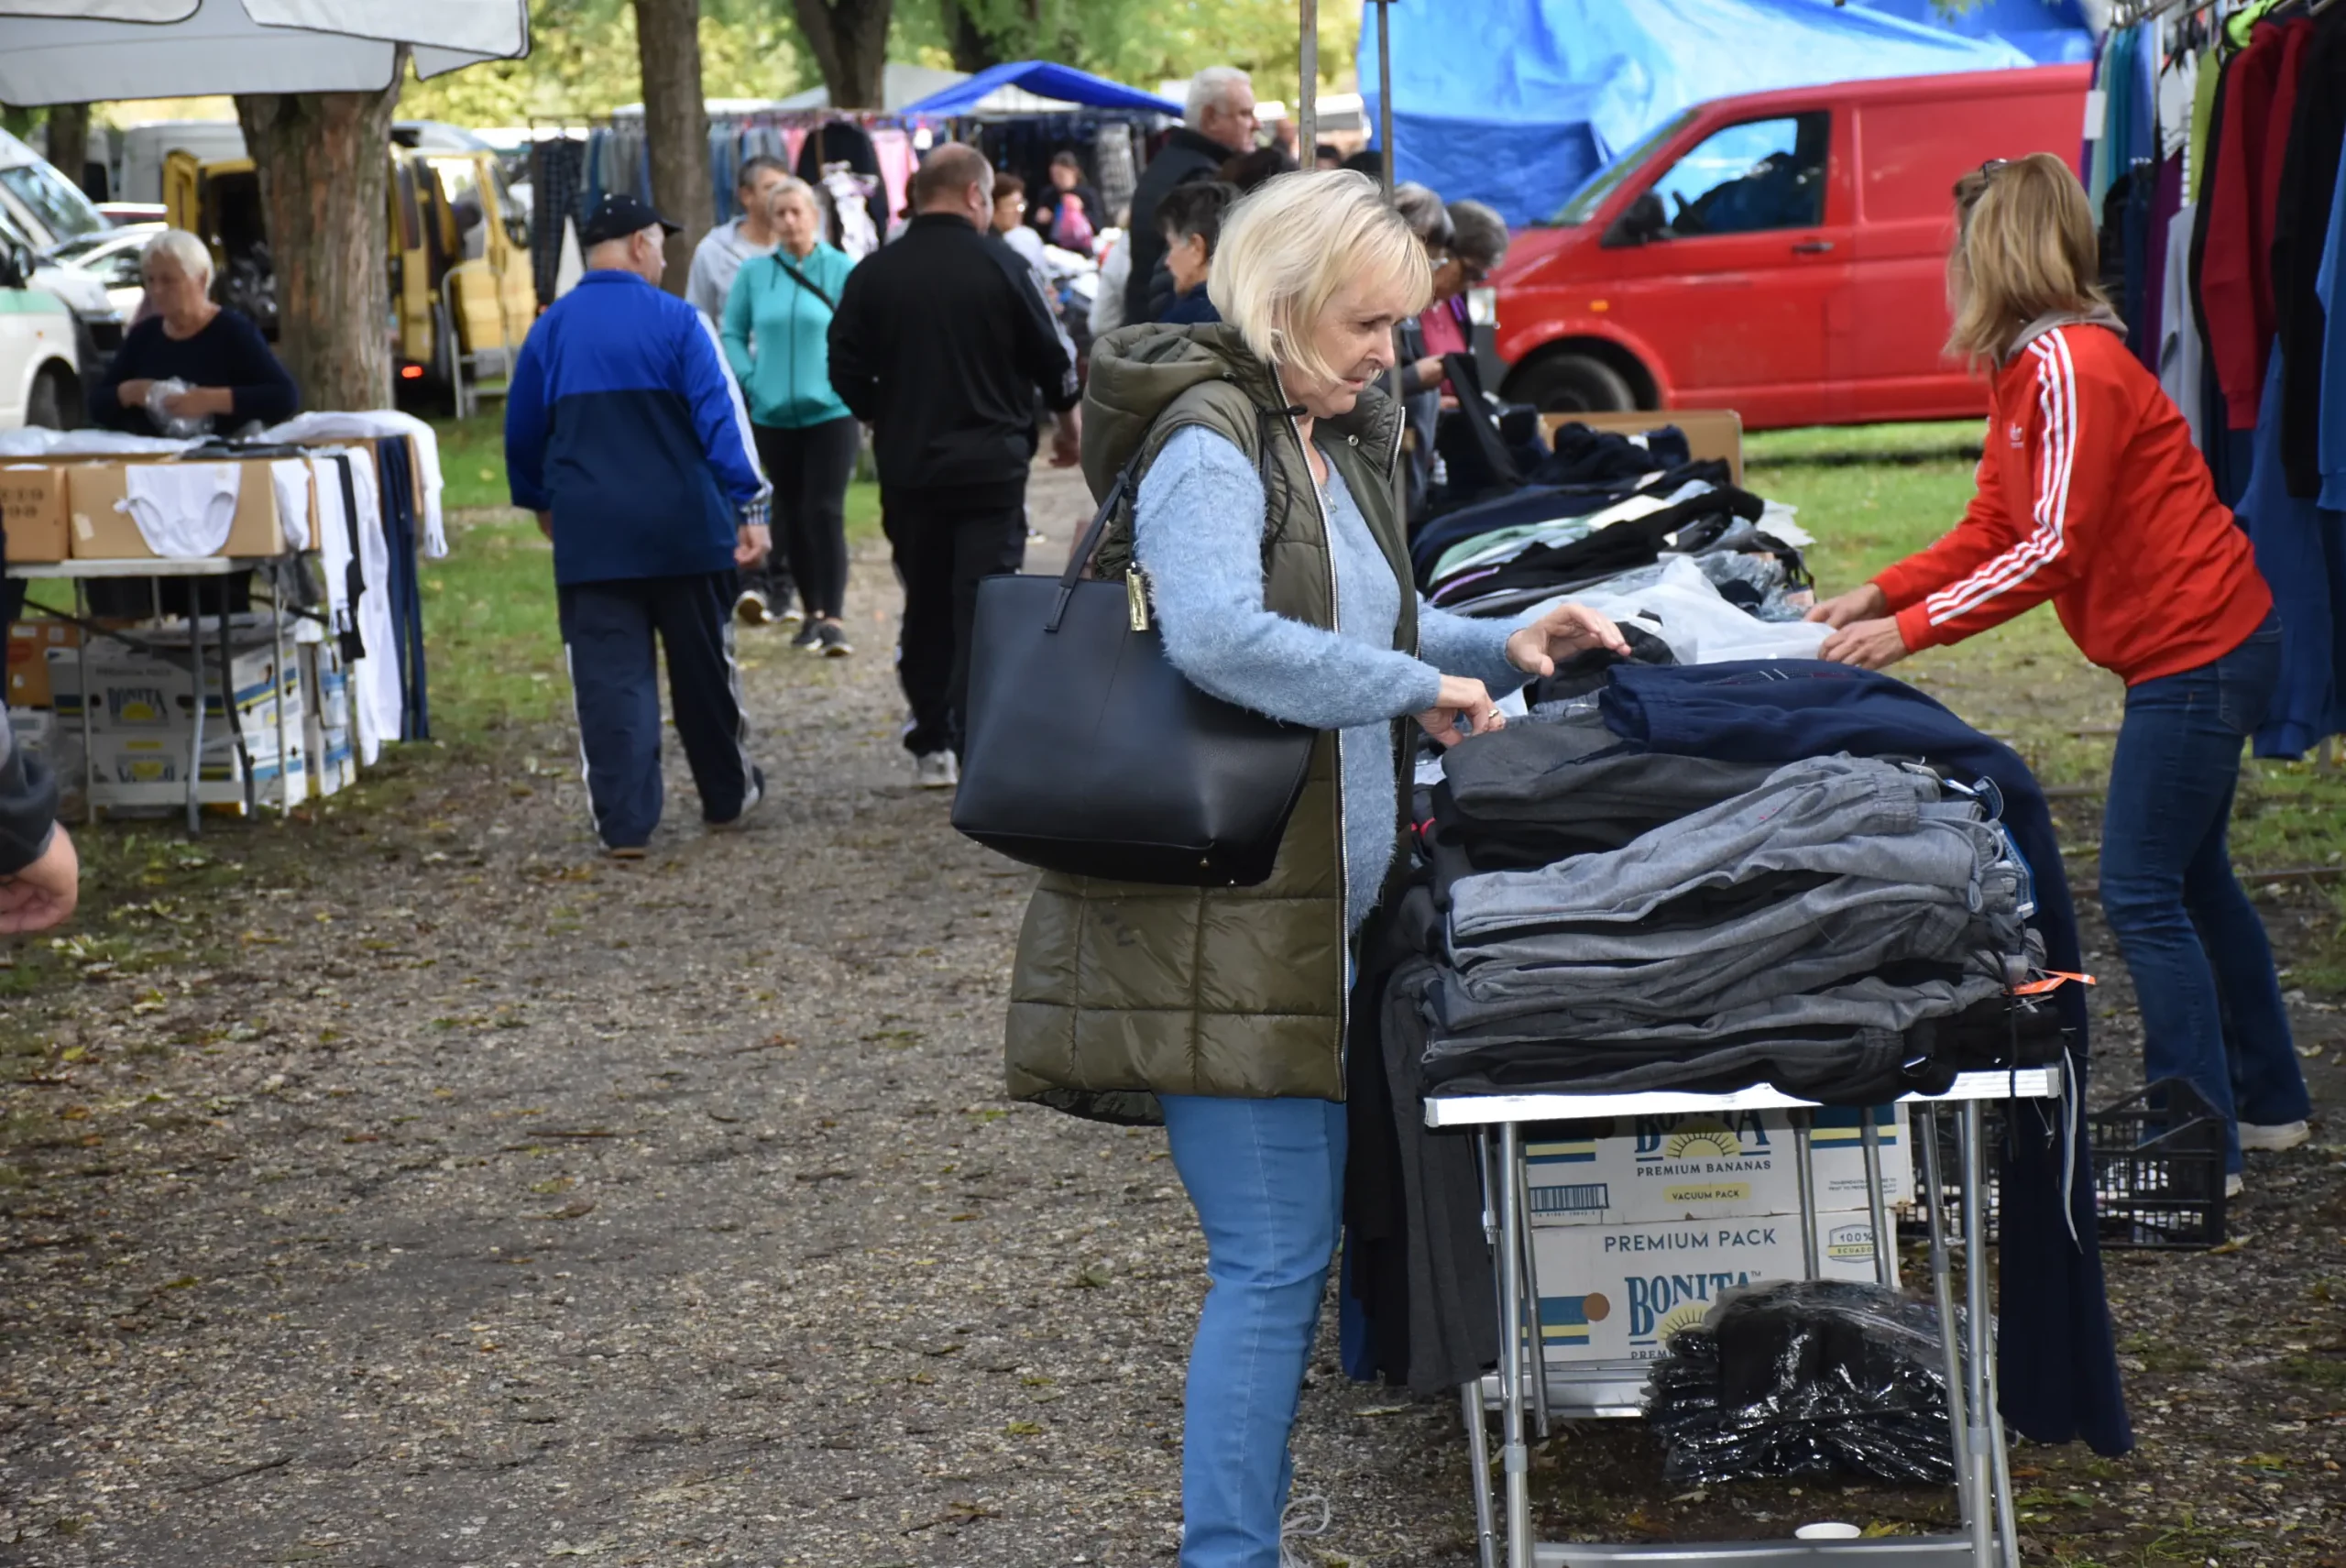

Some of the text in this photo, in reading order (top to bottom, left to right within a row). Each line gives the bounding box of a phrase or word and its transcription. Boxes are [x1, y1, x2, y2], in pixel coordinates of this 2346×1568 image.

[1634, 1108, 1771, 1153] BOA
[1637, 1160, 1771, 1177] PREMIUM BANANAS
[1672, 1190, 1739, 1201] VACUUM PACK
[1604, 1227, 1777, 1253] PREMIUM PACK
[1839, 1232, 1873, 1243] 100%
[1836, 1246, 1873, 1255] ECUADO
[1624, 1271, 1749, 1337] BONIT
[1630, 1349, 1668, 1360] PREM
